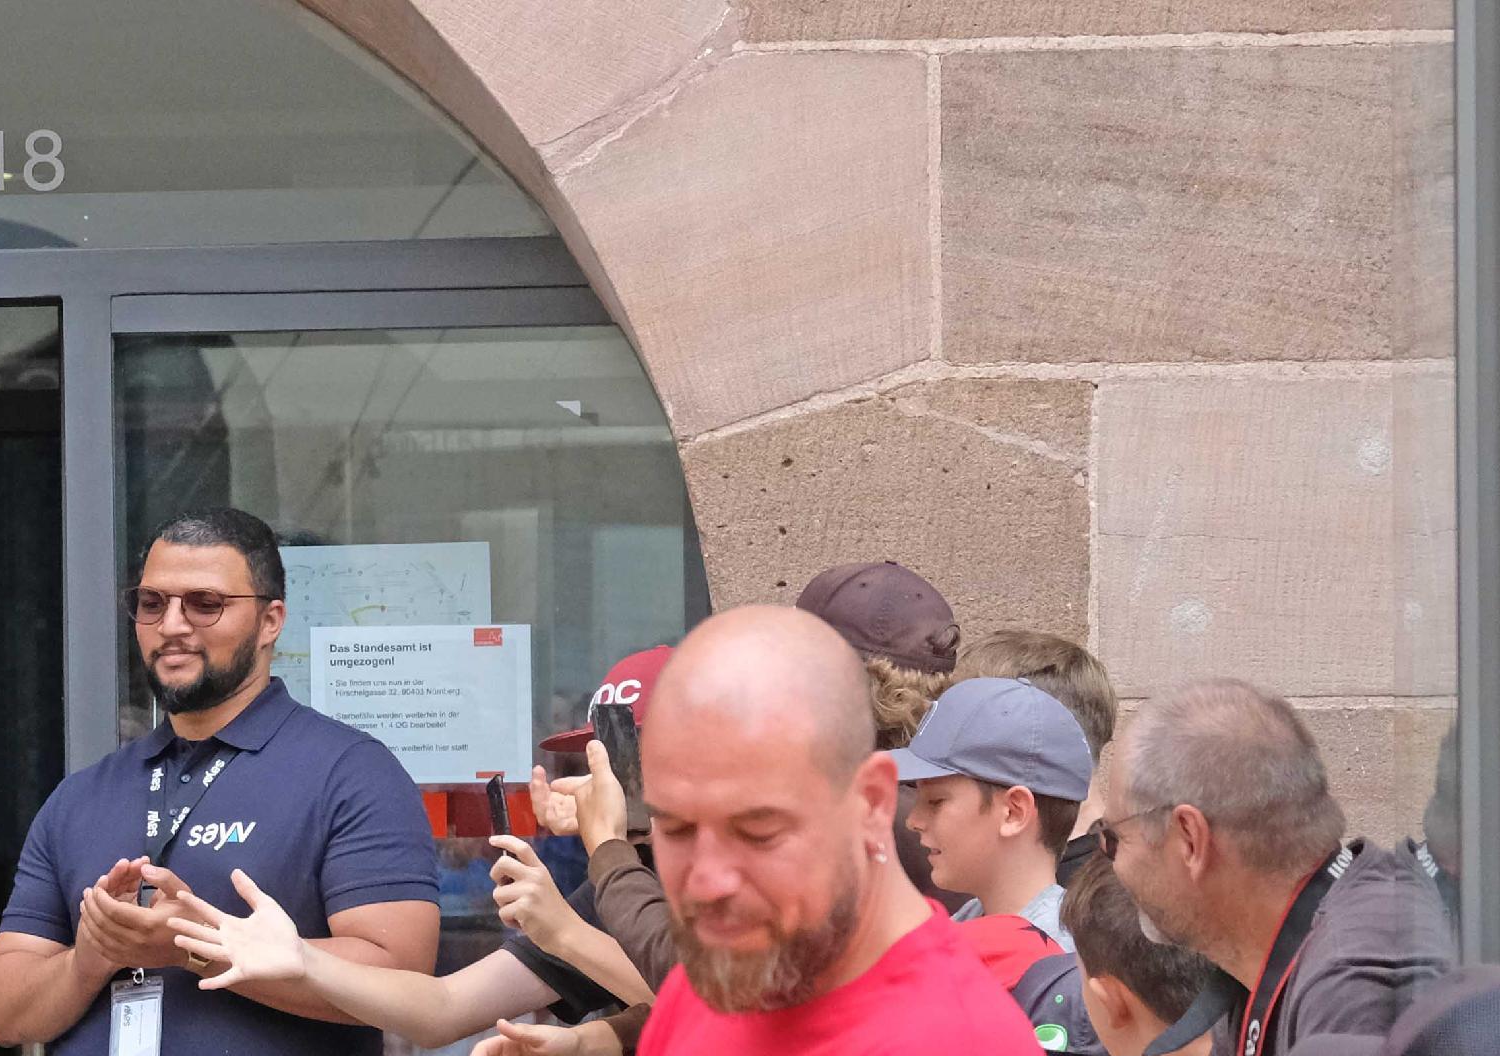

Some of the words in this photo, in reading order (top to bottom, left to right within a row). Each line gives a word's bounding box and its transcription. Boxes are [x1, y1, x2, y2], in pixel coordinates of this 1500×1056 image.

[329, 644, 350, 653] Das
[353, 643, 417, 653] Standesamt
[419, 642, 432, 652] ist
[329, 656, 395, 668] umgezogen!
